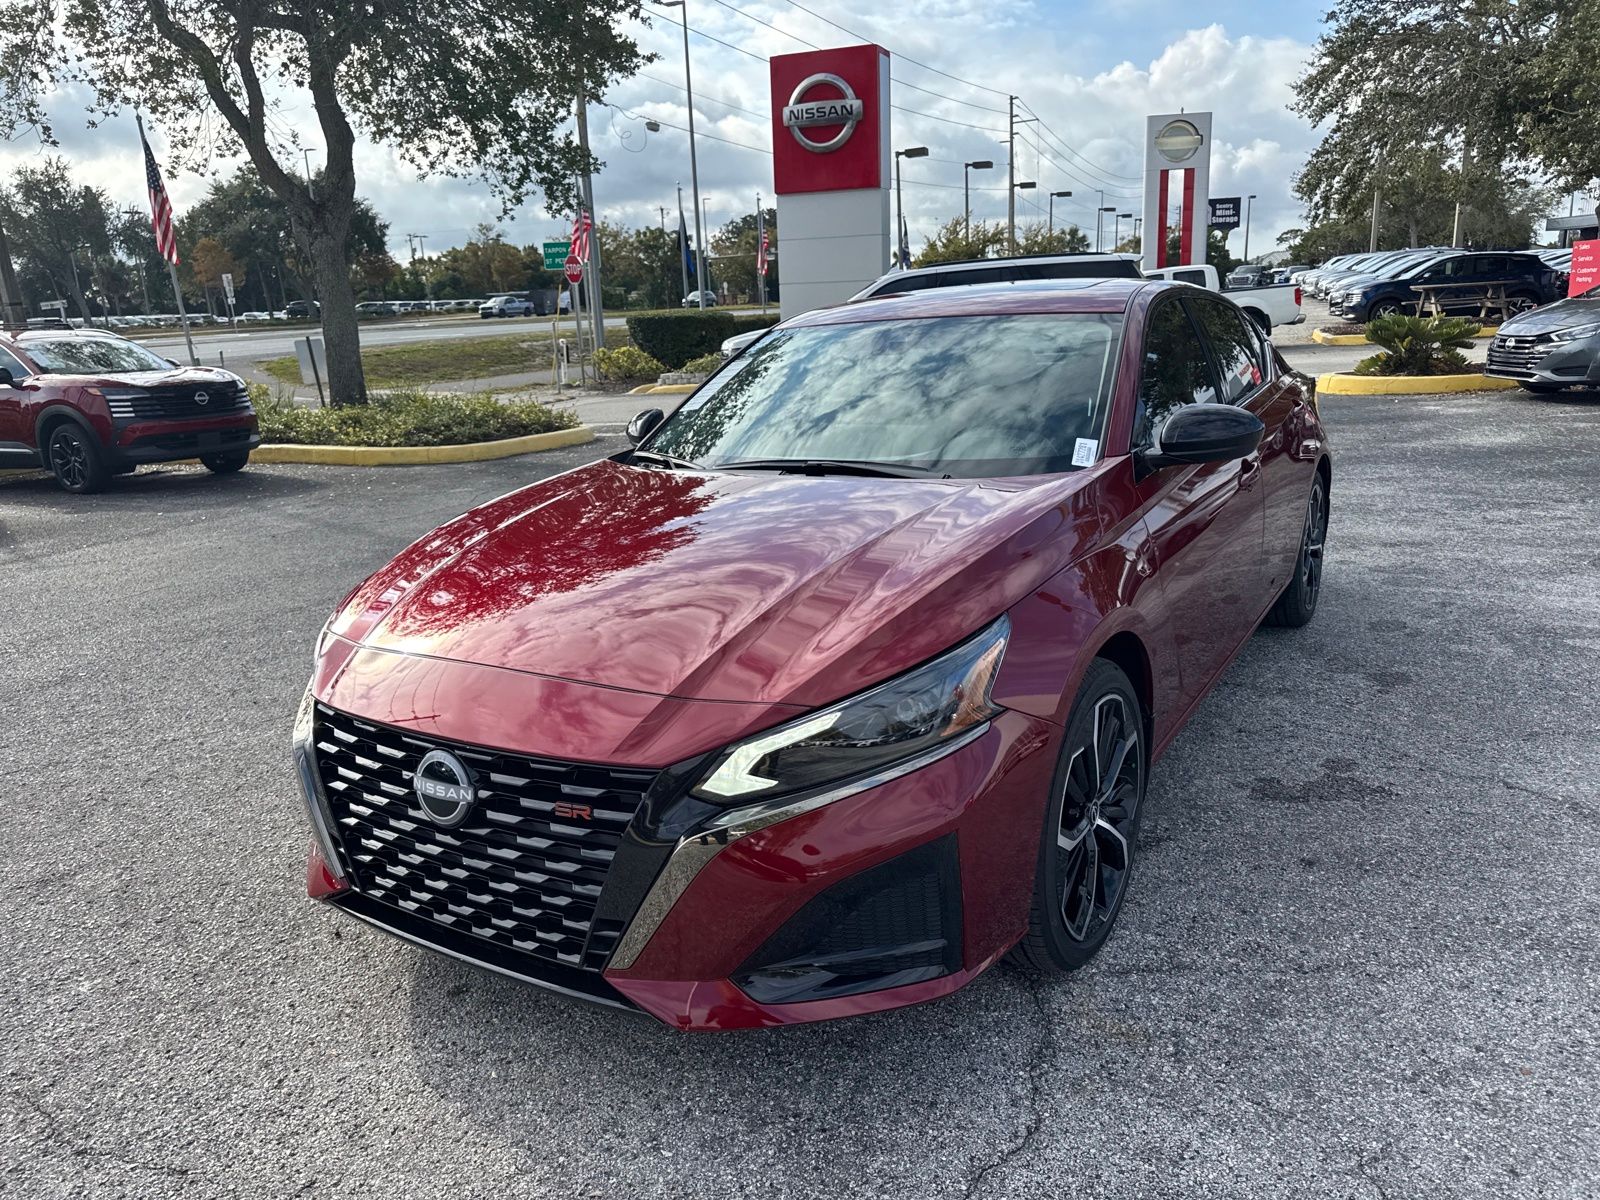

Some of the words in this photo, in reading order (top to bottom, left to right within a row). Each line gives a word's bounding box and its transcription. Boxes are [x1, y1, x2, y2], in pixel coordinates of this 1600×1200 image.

[789, 104, 853, 121] NISSAN
[566, 264, 581, 275] STOP
[413, 777, 471, 800] NISSAN
[554, 801, 592, 820] SR
